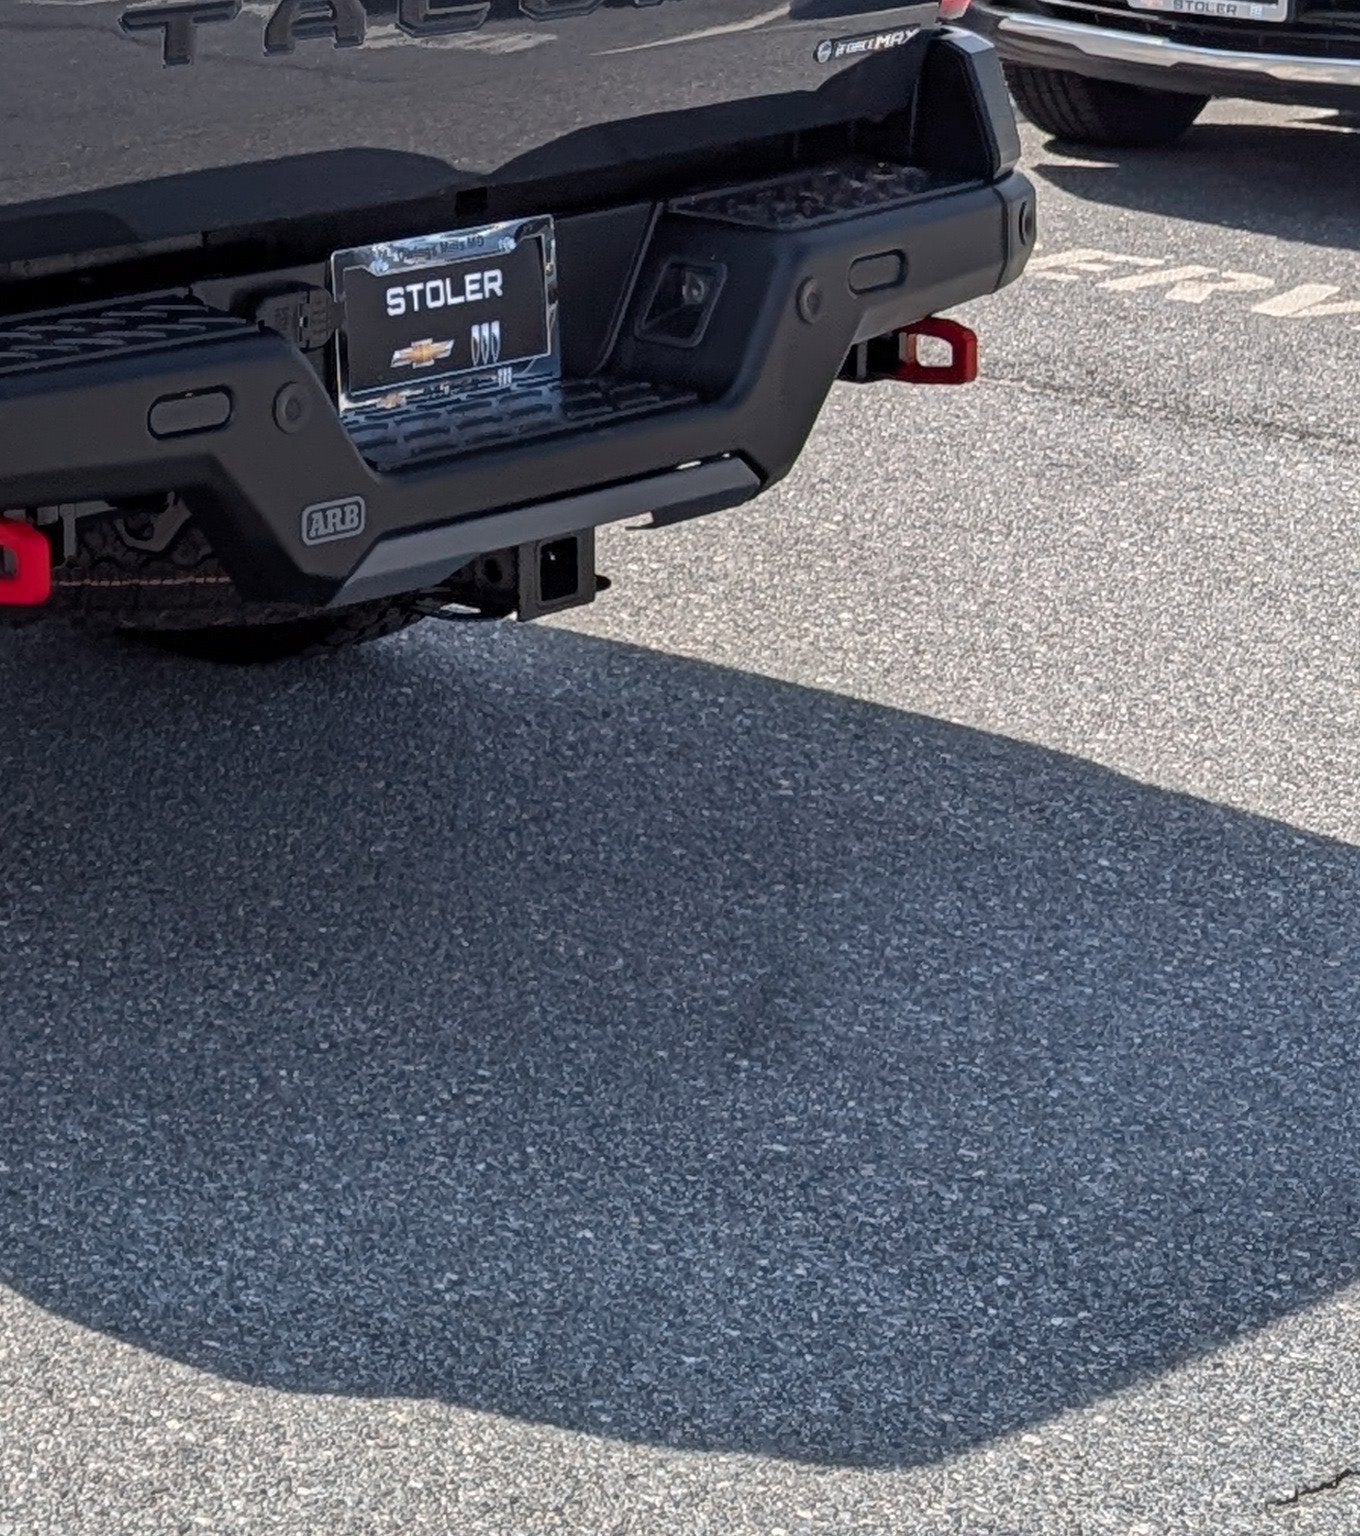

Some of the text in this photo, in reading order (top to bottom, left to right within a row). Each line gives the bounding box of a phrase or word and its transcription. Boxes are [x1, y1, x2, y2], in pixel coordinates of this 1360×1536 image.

[1173, 0, 1238, 14] STOLER
[387, 269, 503, 316] STOLER
[308, 504, 360, 537] ARB
